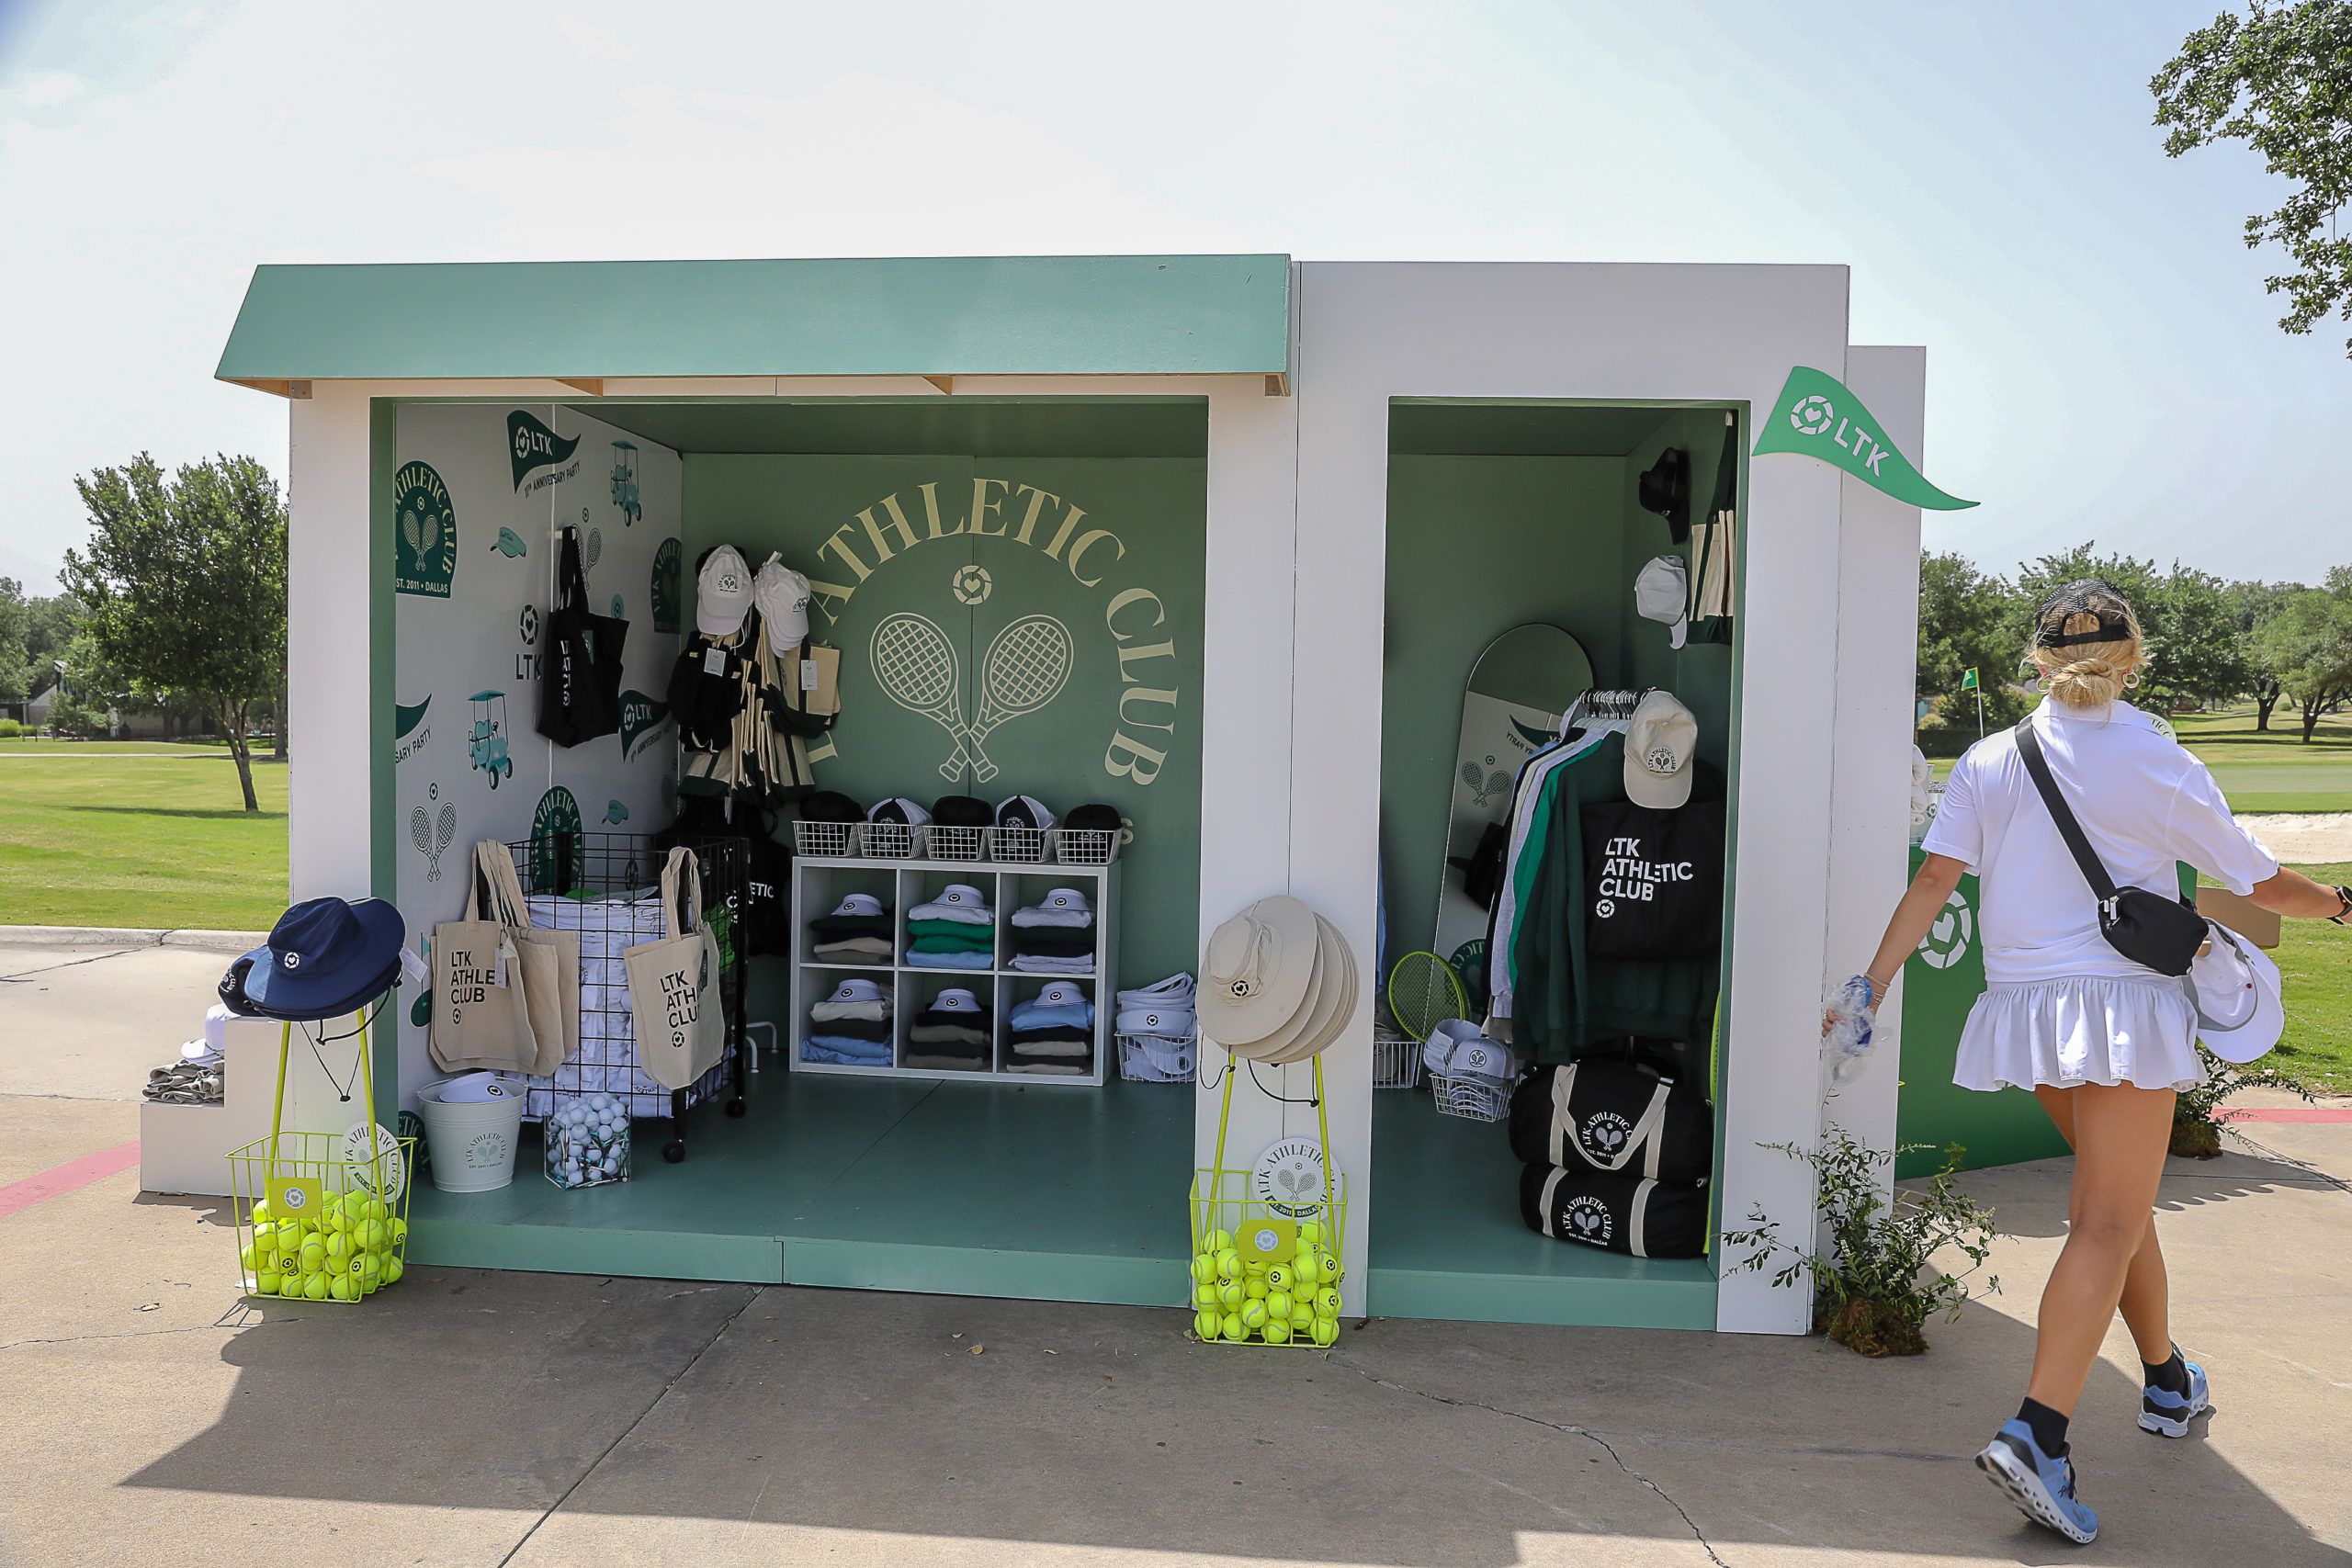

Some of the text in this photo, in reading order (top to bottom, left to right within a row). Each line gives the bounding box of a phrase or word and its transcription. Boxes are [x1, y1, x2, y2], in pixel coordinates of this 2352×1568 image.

[531, 431, 553, 457] LTK
[1834, 417, 1890, 478] LTK
[441, 508, 455, 574] CLUB
[395, 578, 448, 593] ST. 2011 DALLAS
[809, 477, 1179, 786] ATHLETIC CLUB
[515, 653, 542, 681] LTK
[635, 704, 652, 720] LTK
[412, 725, 431, 753] PARTY
[1605, 837, 1641, 858] LTK
[1601, 858, 1694, 883] ATHLETIC
[1599, 877, 1655, 902] CLUB
[450, 950, 472, 967] LTK
[450, 968, 496, 987] ATHLE
[660, 969, 690, 994] LTK
[450, 987, 486, 1005] CLUB
[668, 1004, 699, 1029] CLU
[348, 1125, 396, 1149] ATHLTIC
[1581, 1111, 1630, 1145] LTK ATHLETIC
[1258, 1168, 1272, 1194] LTK
[1562, 1196, 1612, 1240] LTK ATHLETIC CLUB
